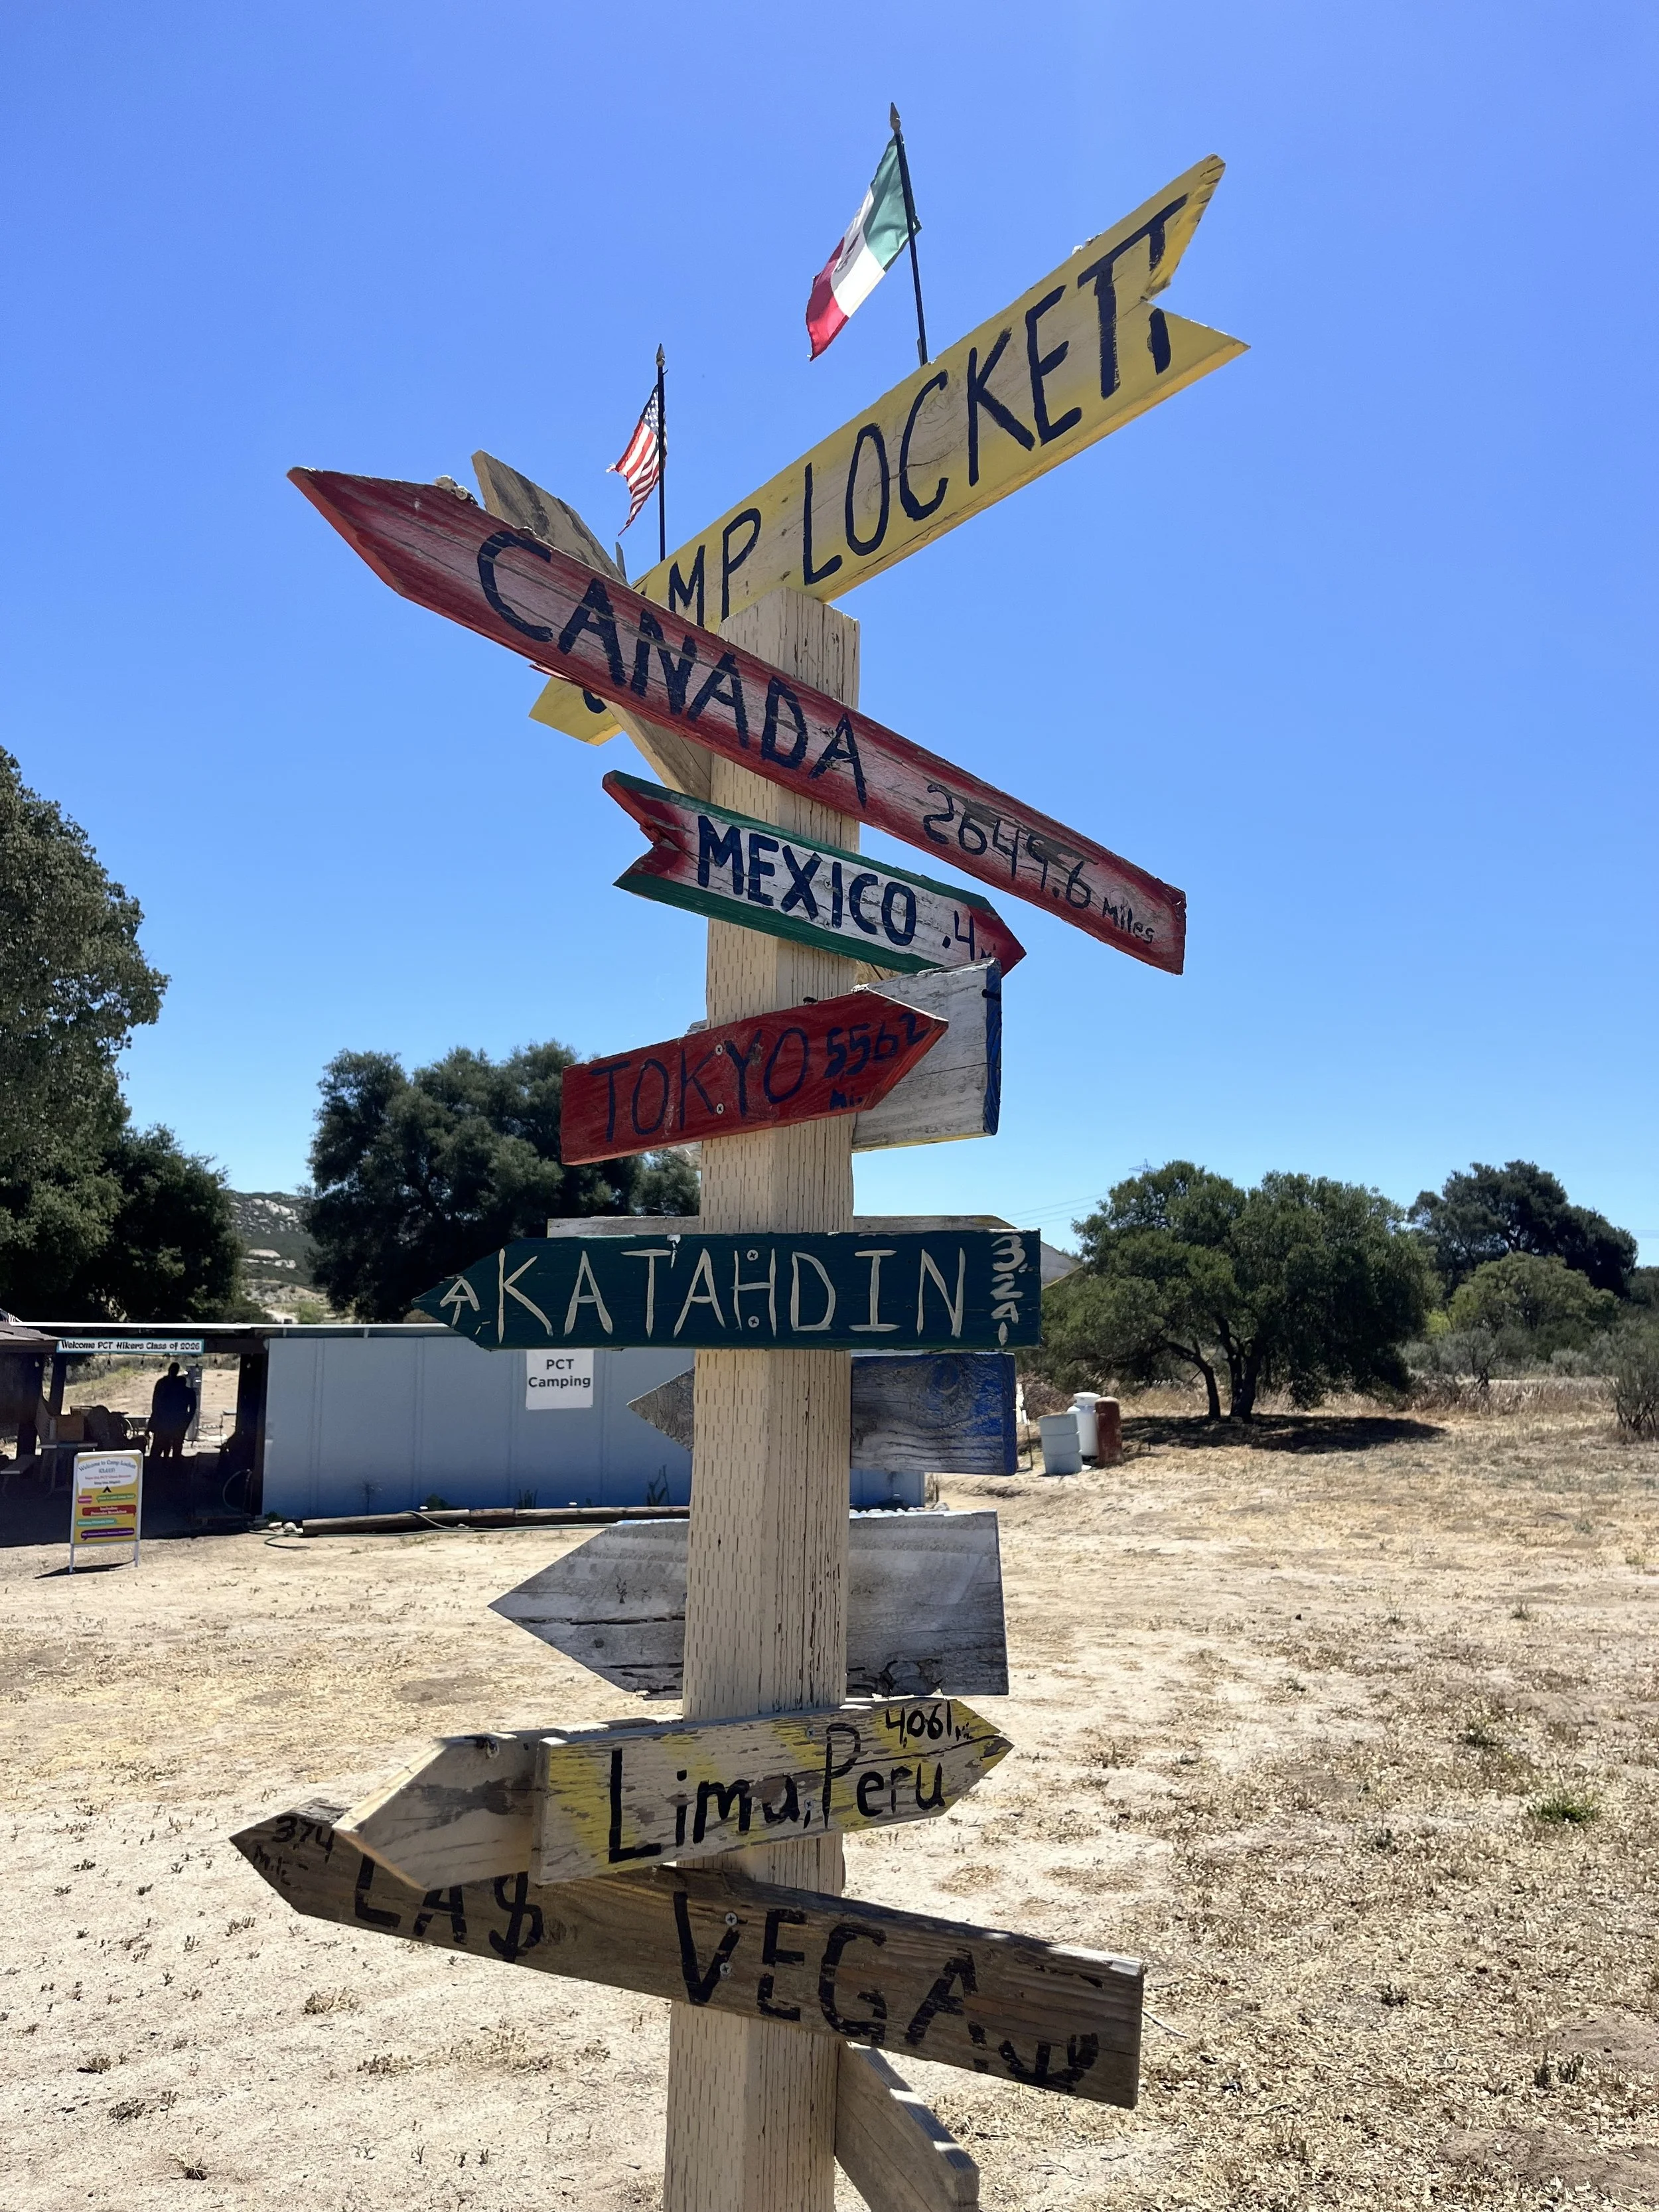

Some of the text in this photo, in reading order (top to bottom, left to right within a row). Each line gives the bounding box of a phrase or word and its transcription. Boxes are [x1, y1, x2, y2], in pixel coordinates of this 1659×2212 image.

[802, 193, 1189, 586] LOCKETT
[477, 530, 867, 808] CANADA
[922, 783, 1092, 910] 2649.6
[697, 815, 918, 947] MEXICO
[589, 1027, 810, 1143] TOKYO
[61, 1339, 96, 1349] Welcome
[116, 1341, 144, 1350] Hikers
[169, 1342, 179, 1351] of
[496, 1246, 967, 1345] KATAHDIN
[528, 1375, 591, 1388] Camping
[546, 1359, 575, 1370] PCT
[823, 1723, 946, 1830] Peru
